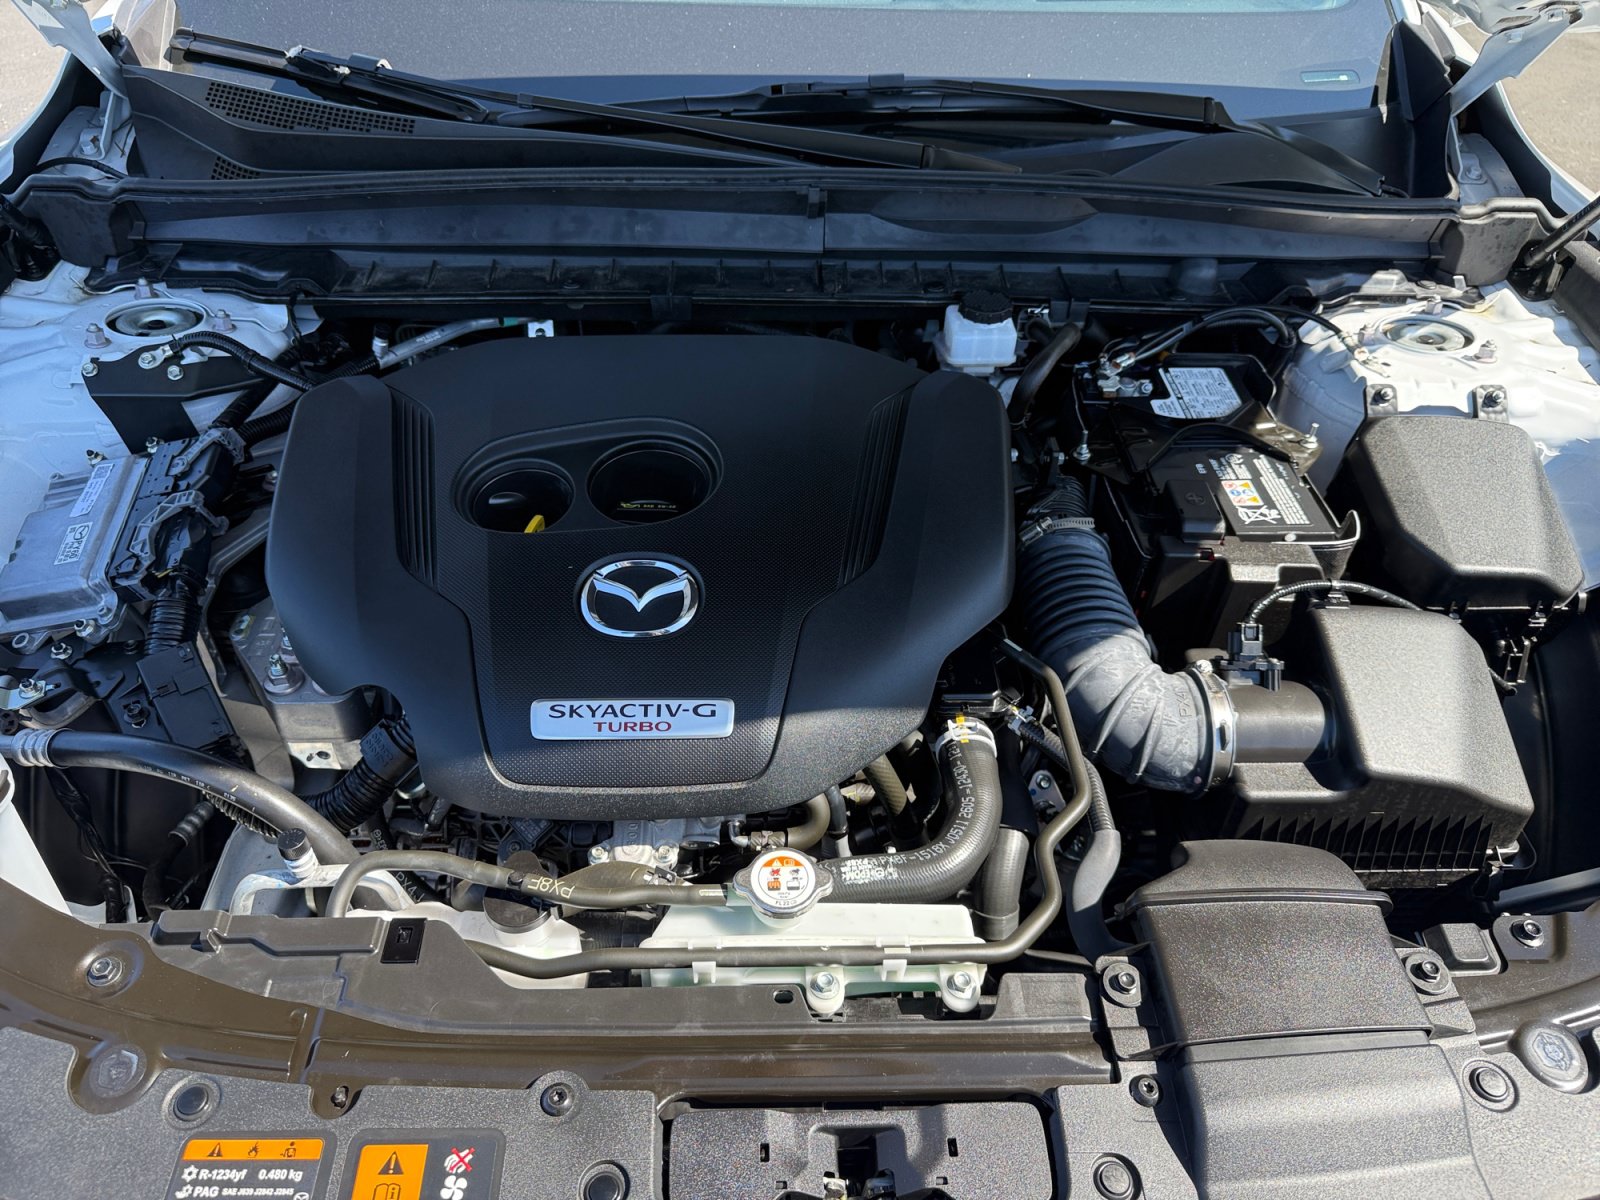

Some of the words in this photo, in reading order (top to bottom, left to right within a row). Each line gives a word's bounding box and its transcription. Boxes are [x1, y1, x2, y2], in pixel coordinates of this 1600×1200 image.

[548, 703, 717, 719] SKYACTIV-G
[592, 720, 673, 733] TURBO
[959, 796, 975, 819] 2605
[527, 876, 576, 899] PX8F
[198, 1168, 248, 1182] R-1234yf
[258, 1168, 287, 1180] 0.480
[288, 1168, 303, 1182] kg
[192, 1186, 220, 1197] PAG
[221, 1187, 237, 1196] SAE
